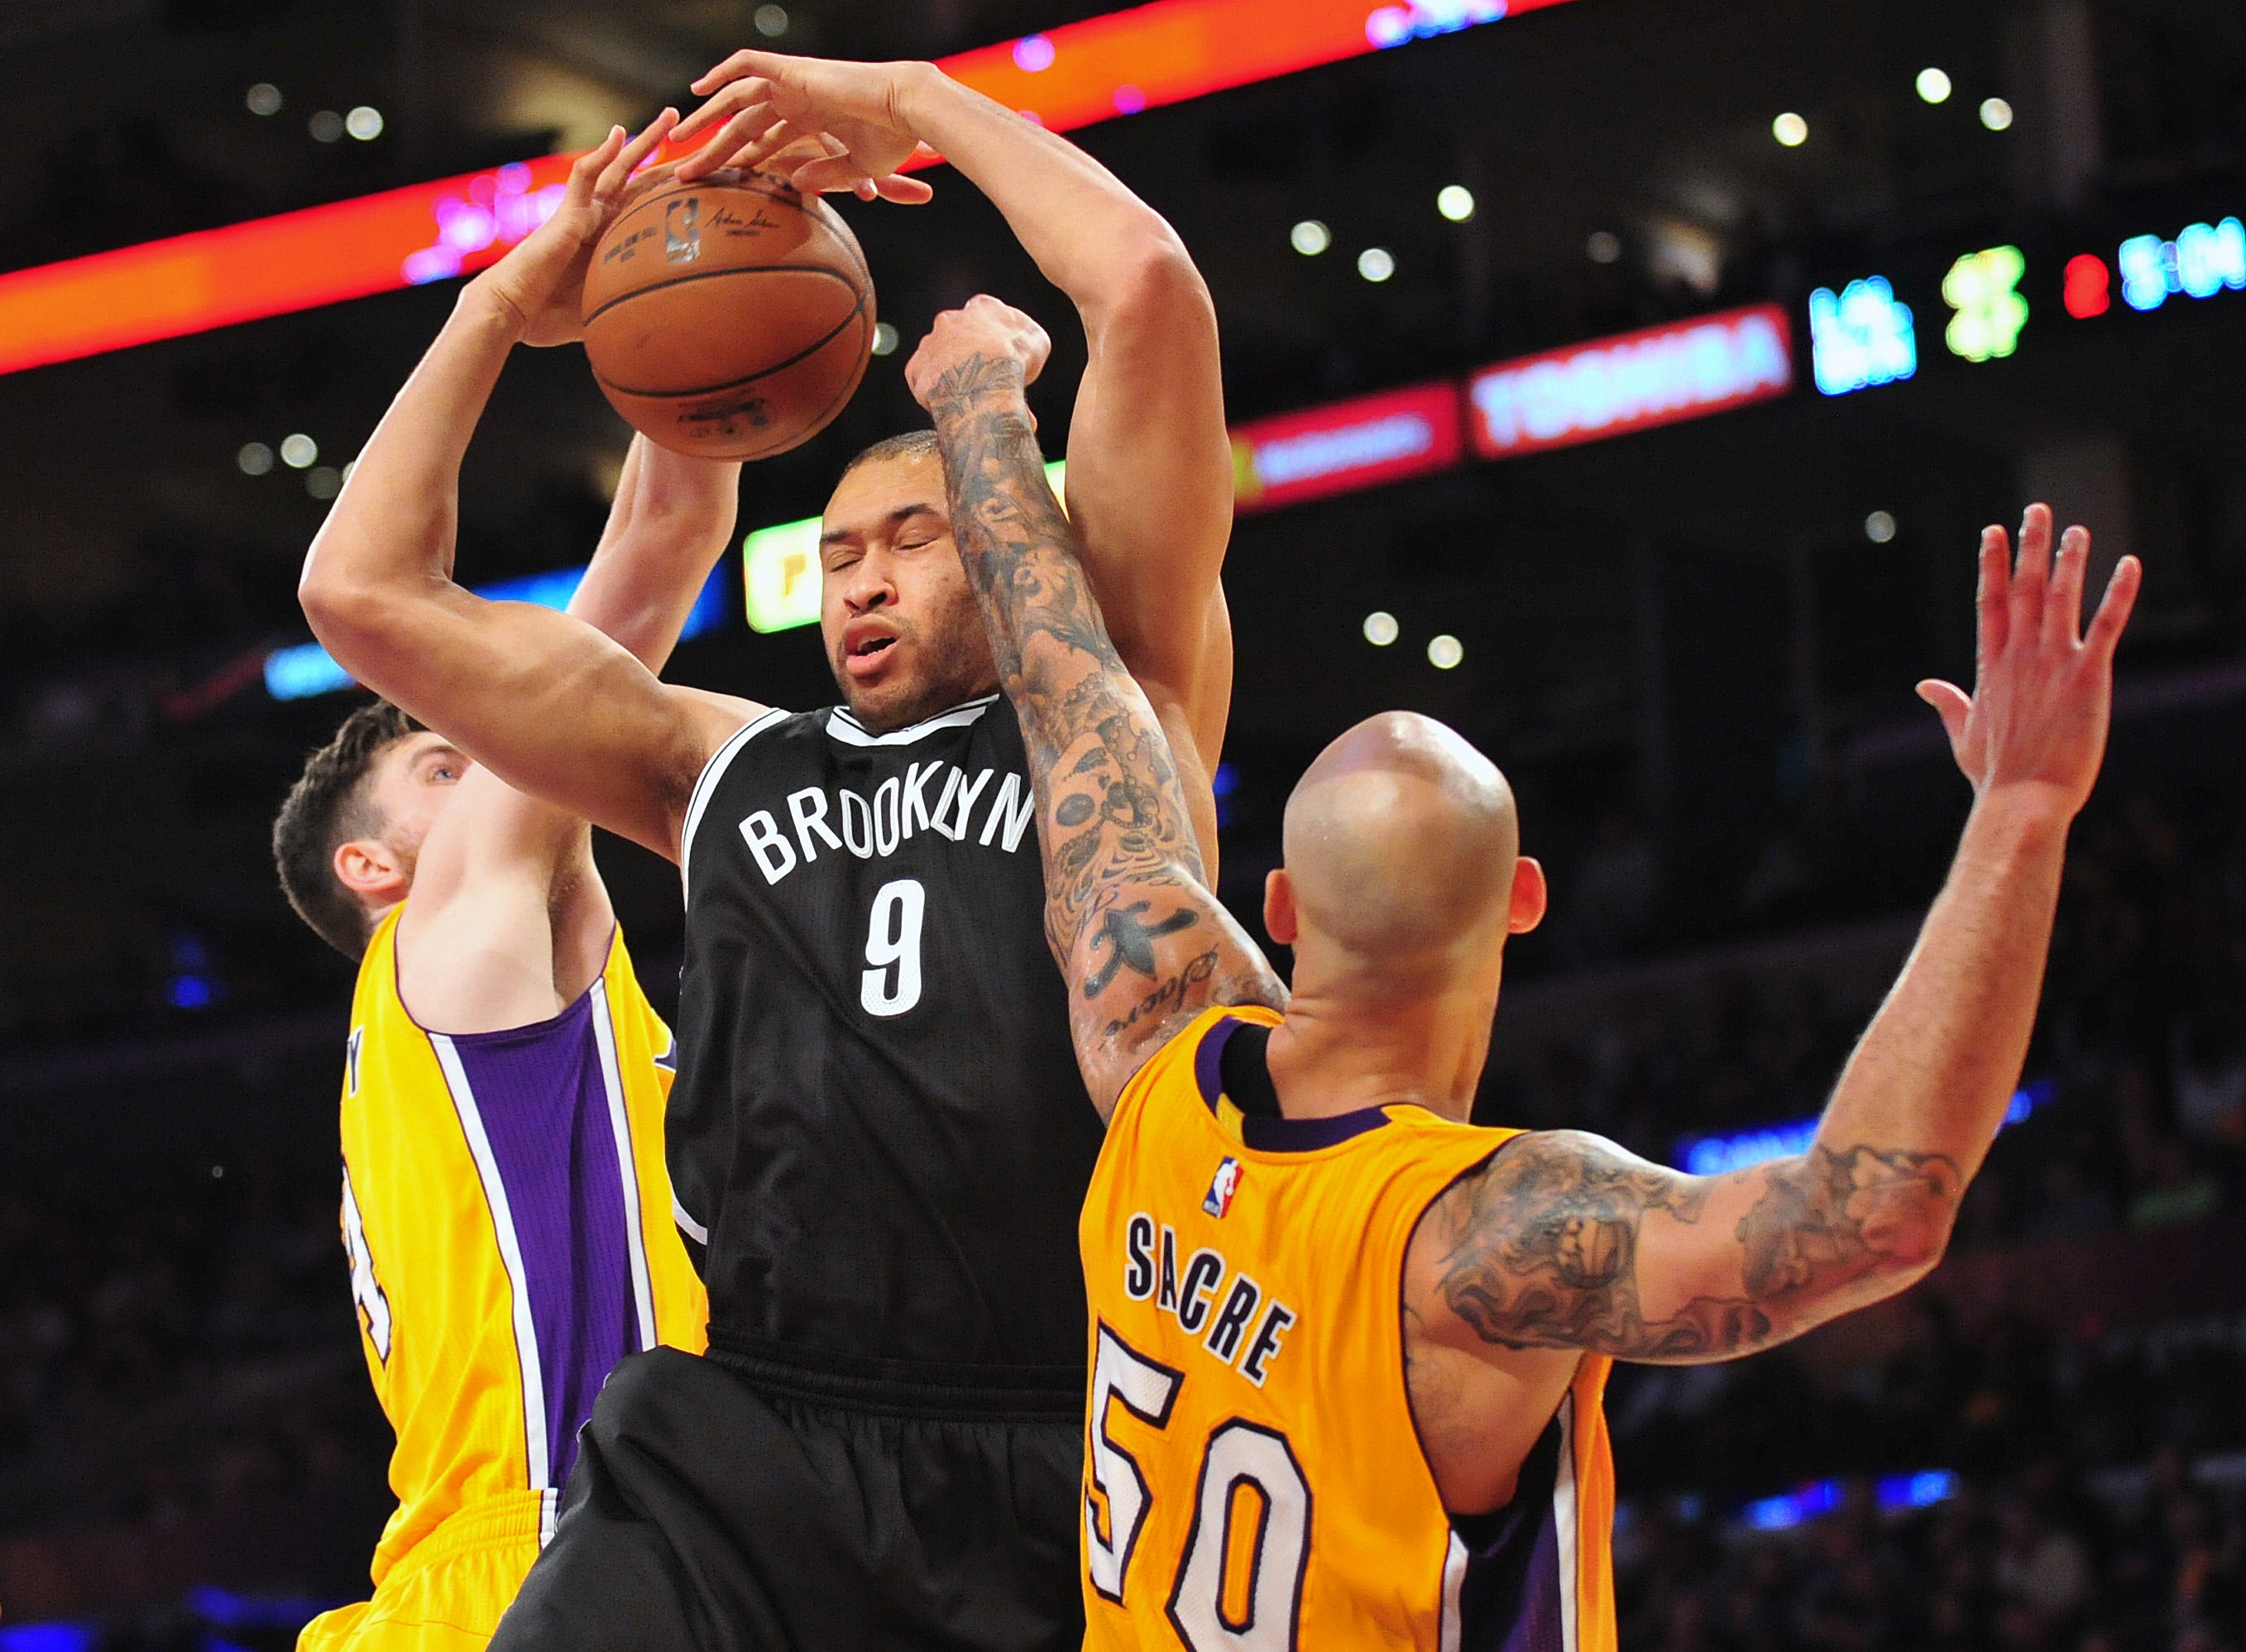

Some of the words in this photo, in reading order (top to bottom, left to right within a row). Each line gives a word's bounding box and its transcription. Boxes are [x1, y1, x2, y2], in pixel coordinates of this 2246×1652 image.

[739, 760, 1034, 885] BROOKLYN
[860, 879, 925, 1017] 9
[1125, 1212, 1297, 1388] SACRE
[1085, 1315, 1312, 1652] 50
